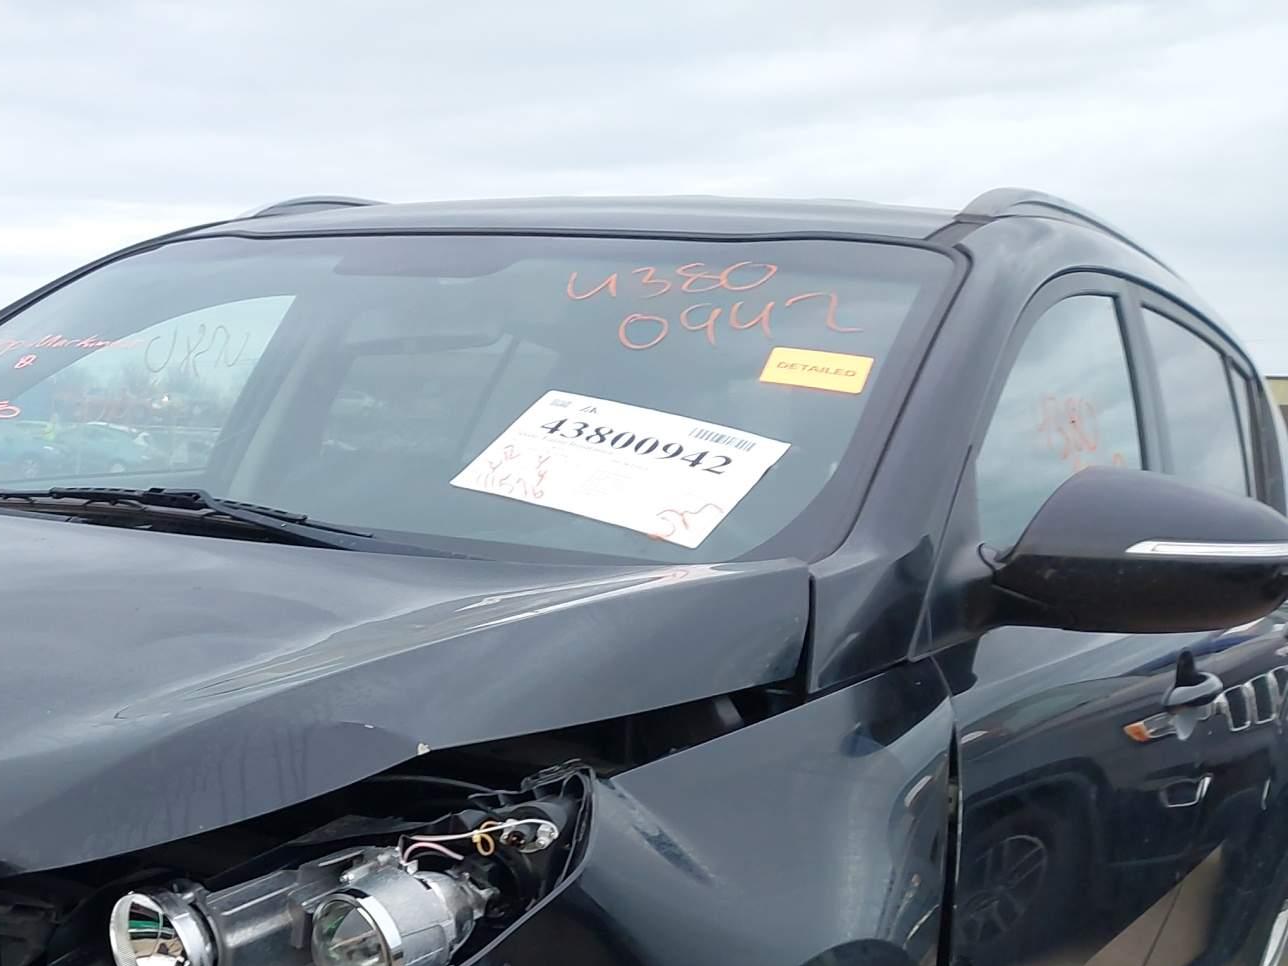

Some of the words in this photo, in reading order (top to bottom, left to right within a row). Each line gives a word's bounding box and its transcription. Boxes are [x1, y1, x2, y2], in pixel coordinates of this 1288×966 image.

[567, 261, 778, 301] 4380
[618, 291, 864, 350] 0942
[776, 360, 857, 377] DETAILED
[539, 417, 733, 476] 43800942
